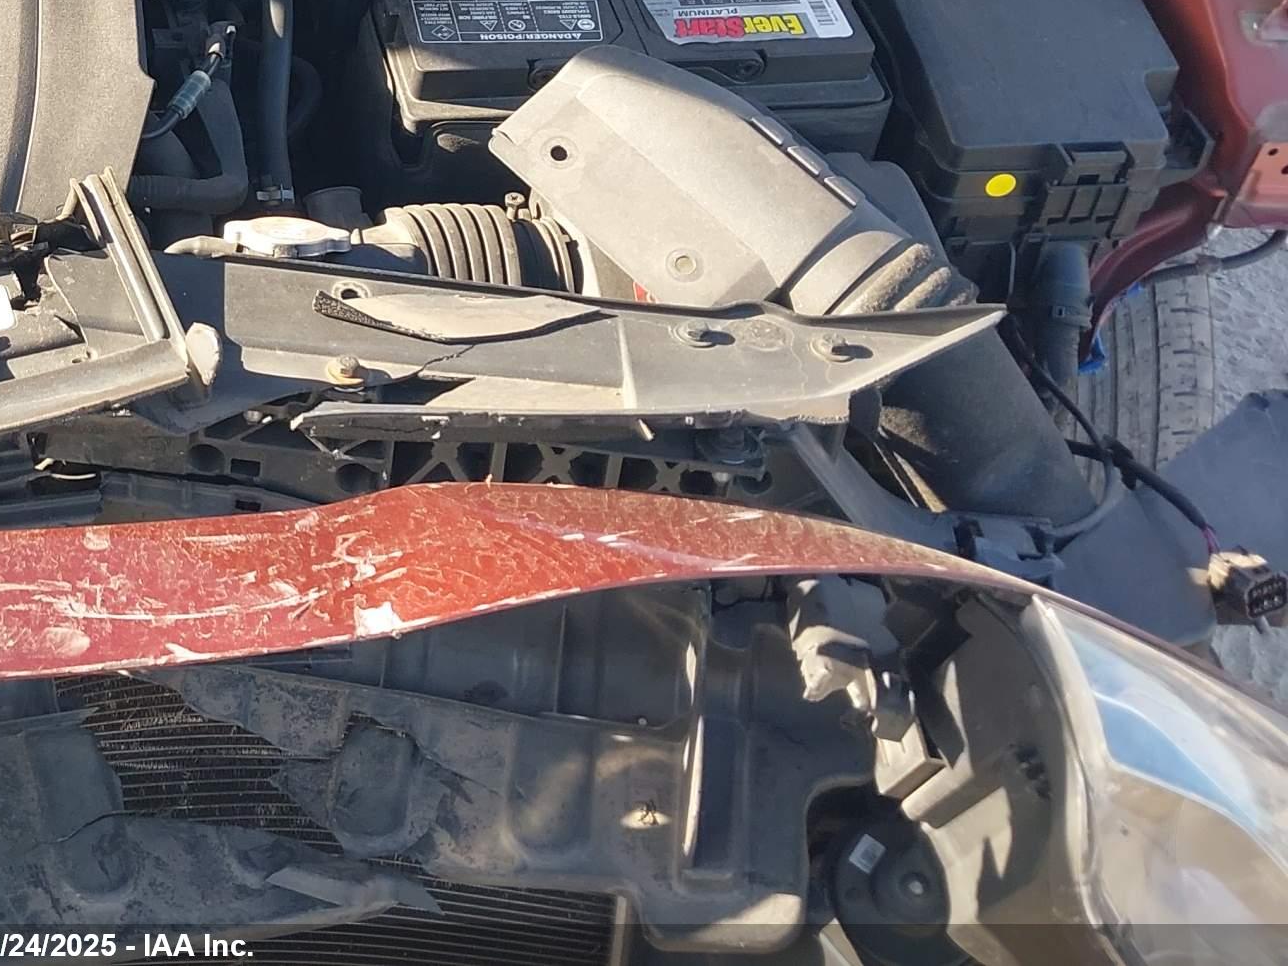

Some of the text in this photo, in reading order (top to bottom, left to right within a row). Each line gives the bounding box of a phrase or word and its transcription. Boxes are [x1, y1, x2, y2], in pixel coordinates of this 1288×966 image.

[677, 8, 738, 17] PLATINUM
[674, 14, 807, 38] EverStart
[479, 32, 572, 41] DANGER/POISON
